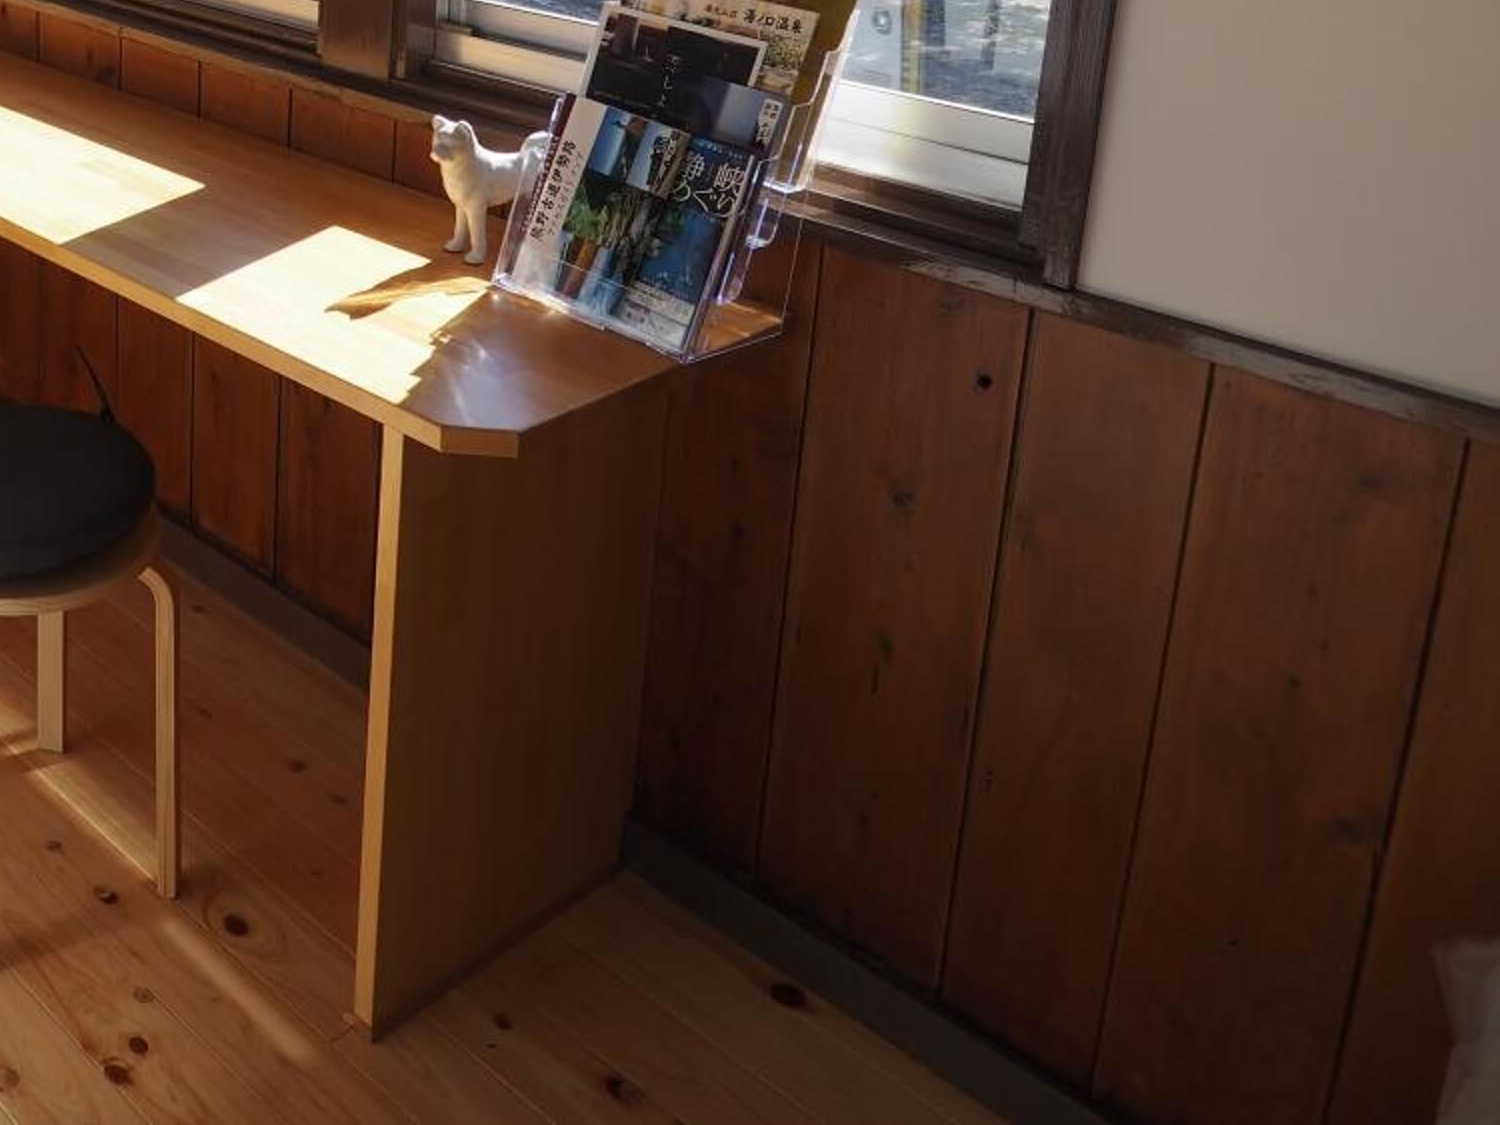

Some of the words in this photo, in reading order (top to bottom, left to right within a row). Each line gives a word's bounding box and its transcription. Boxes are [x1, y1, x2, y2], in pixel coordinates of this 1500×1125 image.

[529, 140, 576, 239] 熊野古道伊勢路
